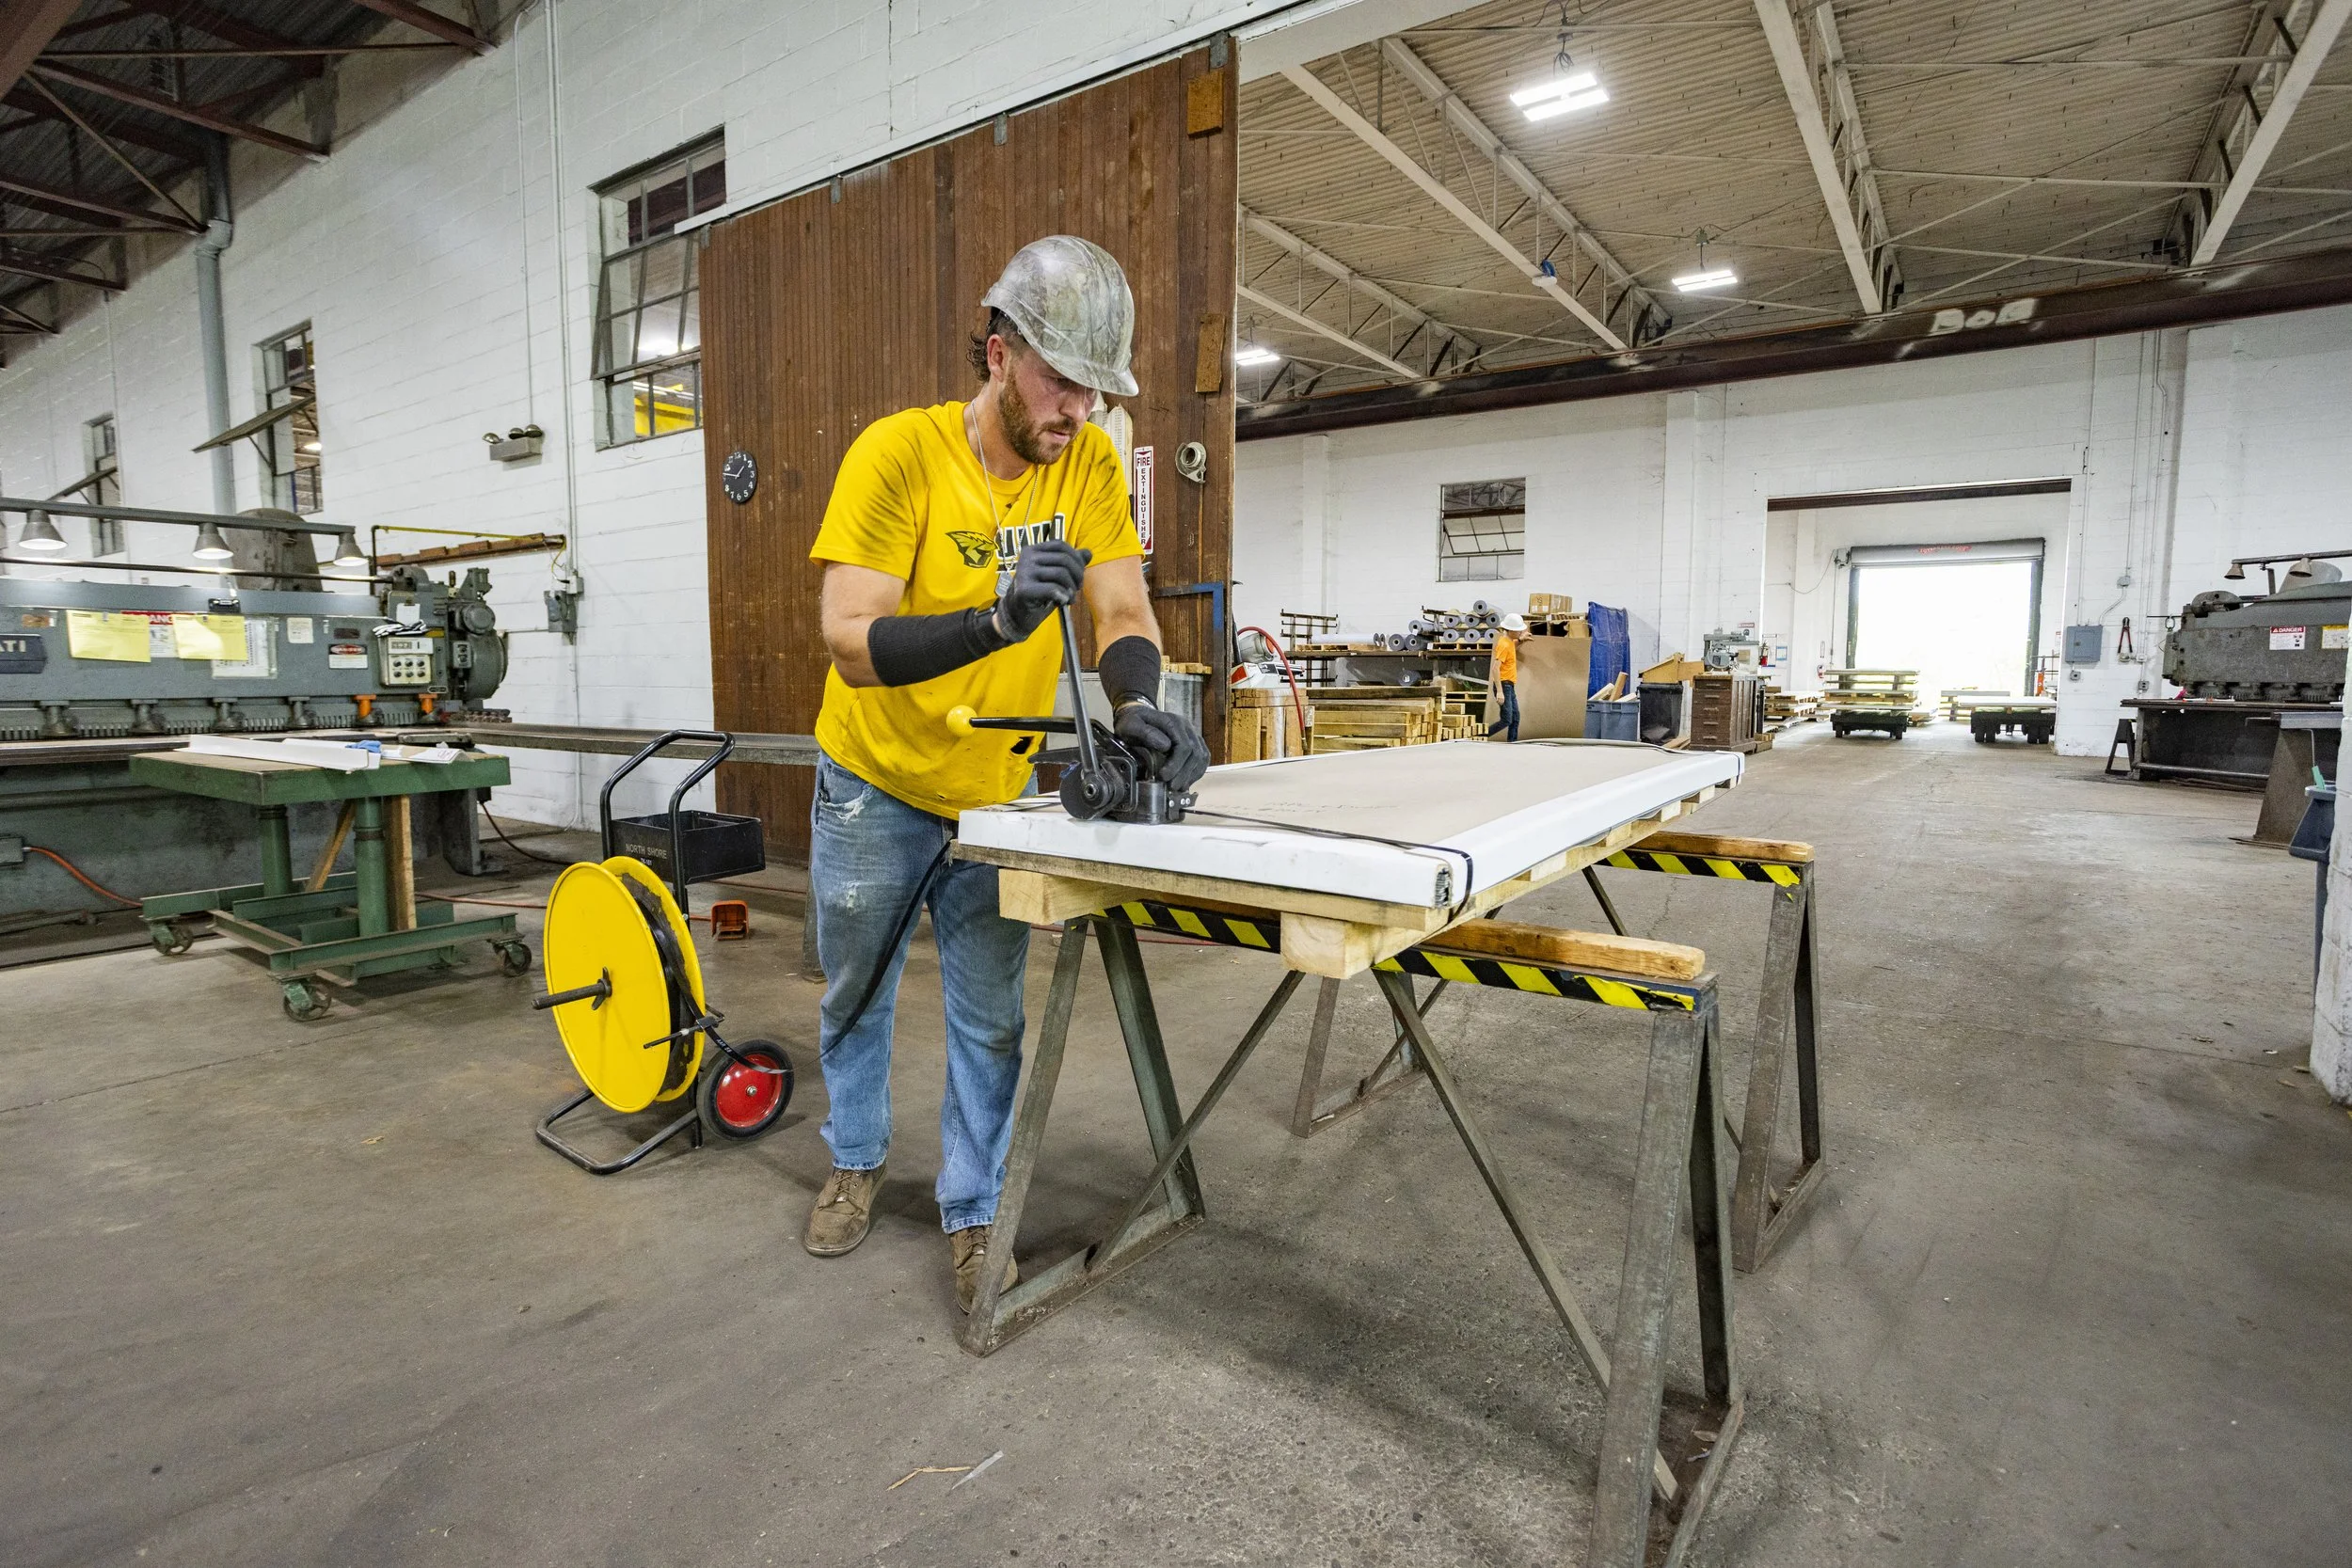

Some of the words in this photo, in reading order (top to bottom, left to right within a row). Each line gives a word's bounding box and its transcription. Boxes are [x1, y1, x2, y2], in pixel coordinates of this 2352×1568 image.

[747, 460, 753, 468] 2
[1136, 456, 1151, 467] FIRE
[724, 483, 730, 492] 8
[748, 481, 754, 489] 4
[730, 491, 735, 499] 7
[626, 843, 645, 855] NORTH
[646, 847, 668, 860] SHORE
